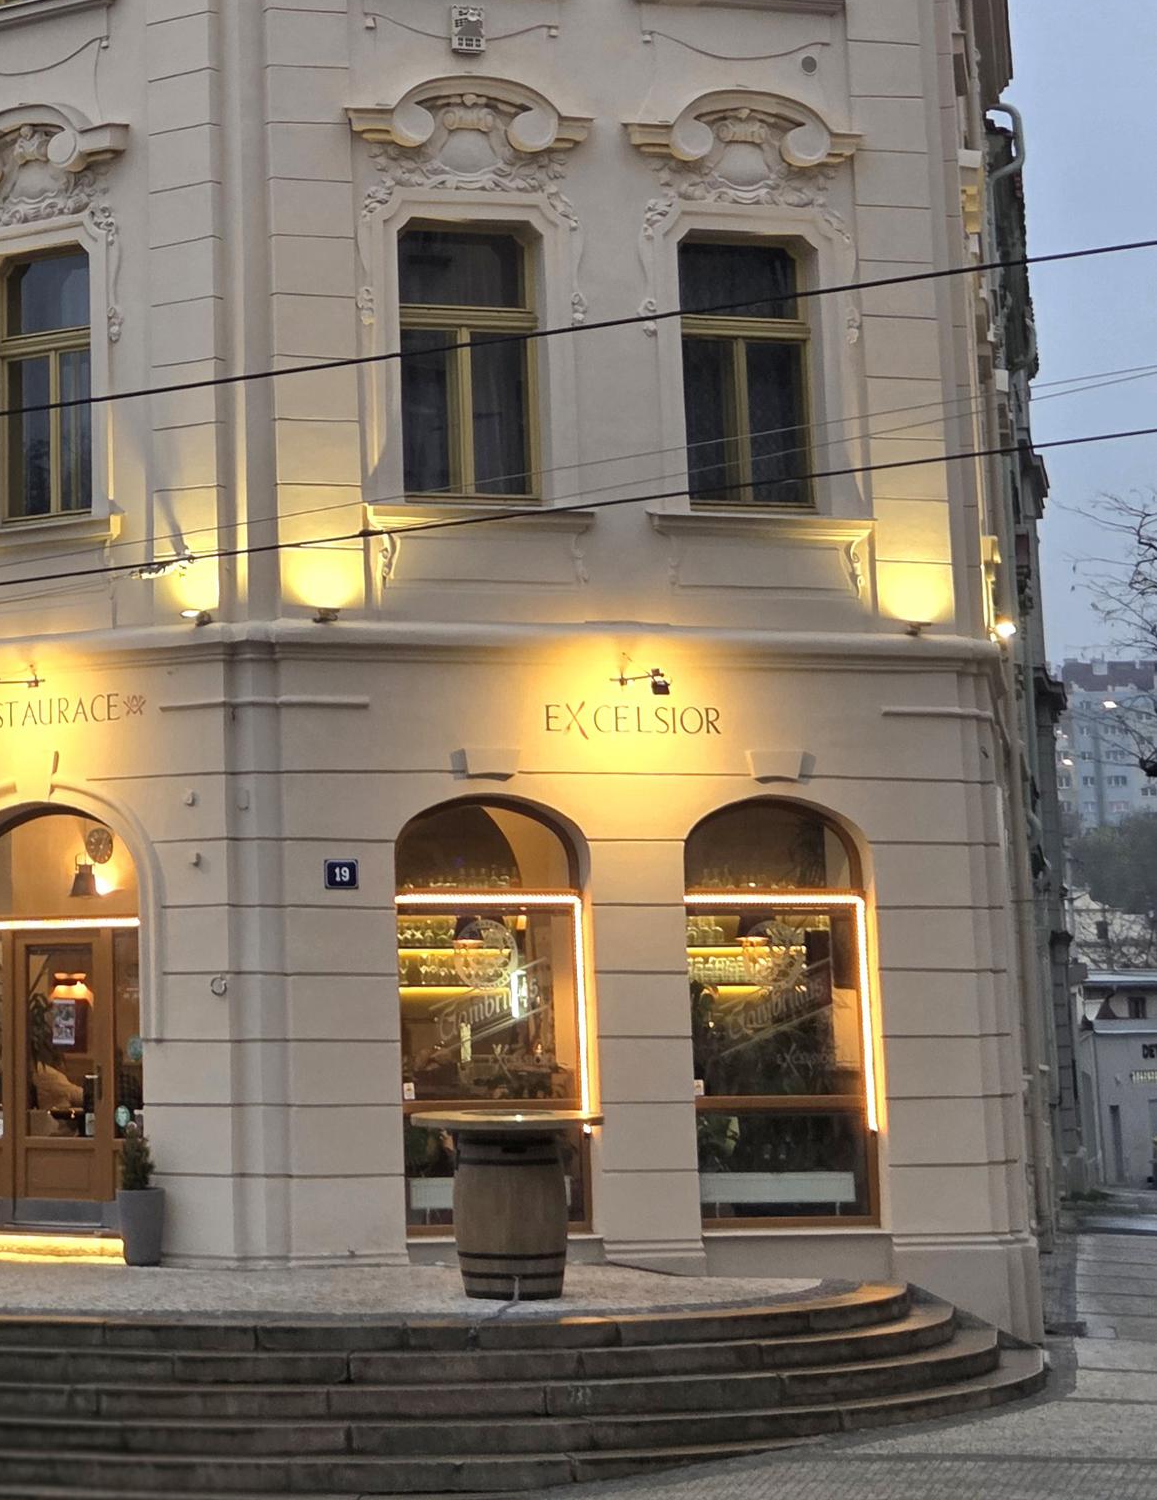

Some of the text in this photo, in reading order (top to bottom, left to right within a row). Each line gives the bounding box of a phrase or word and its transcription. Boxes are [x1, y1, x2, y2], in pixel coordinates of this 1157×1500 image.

[545, 701, 722, 740] EXCELSIOR
[334, 866, 350, 882] 19
[1141, 1043, 1157, 1059] DE
